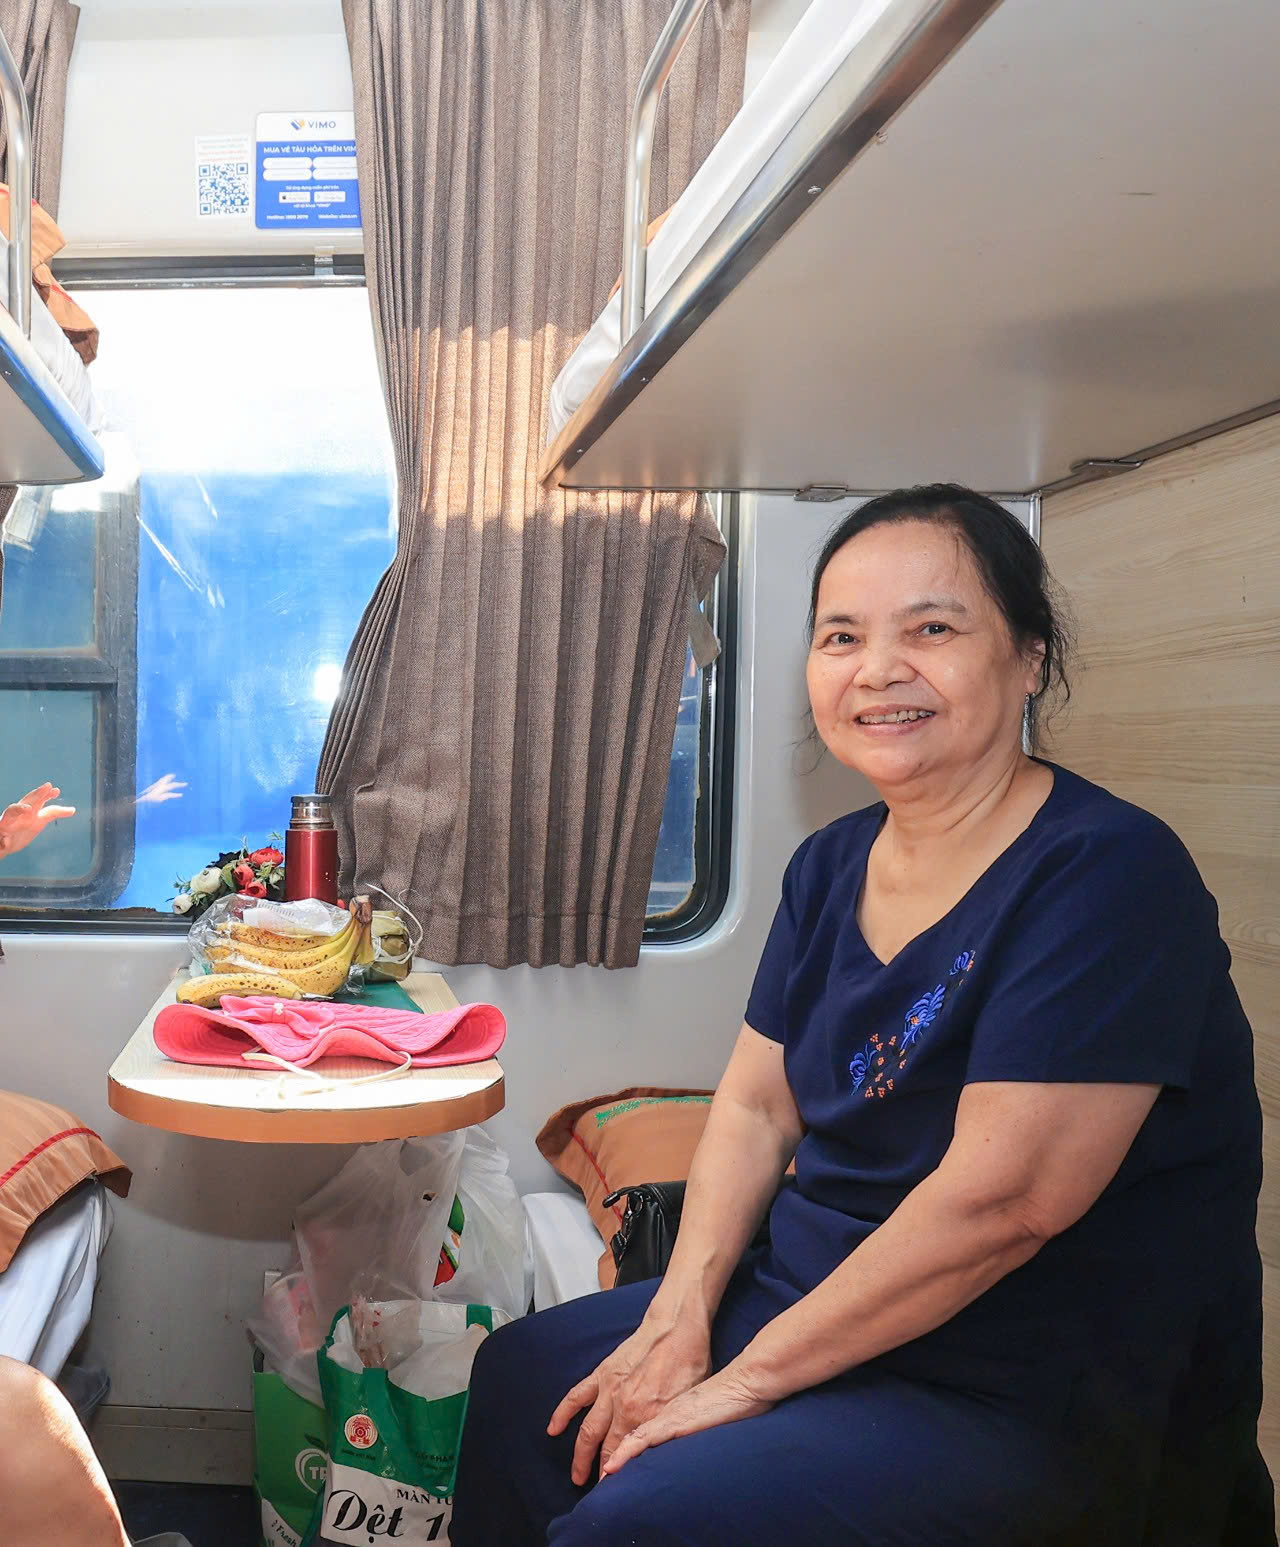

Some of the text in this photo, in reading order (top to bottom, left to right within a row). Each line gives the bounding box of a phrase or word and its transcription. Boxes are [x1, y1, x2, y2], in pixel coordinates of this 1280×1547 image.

[307, 120, 337, 129] VIMO
[396, 1489, 431, 1505] MÀN
[326, 1490, 452, 1544] Dệt 1
